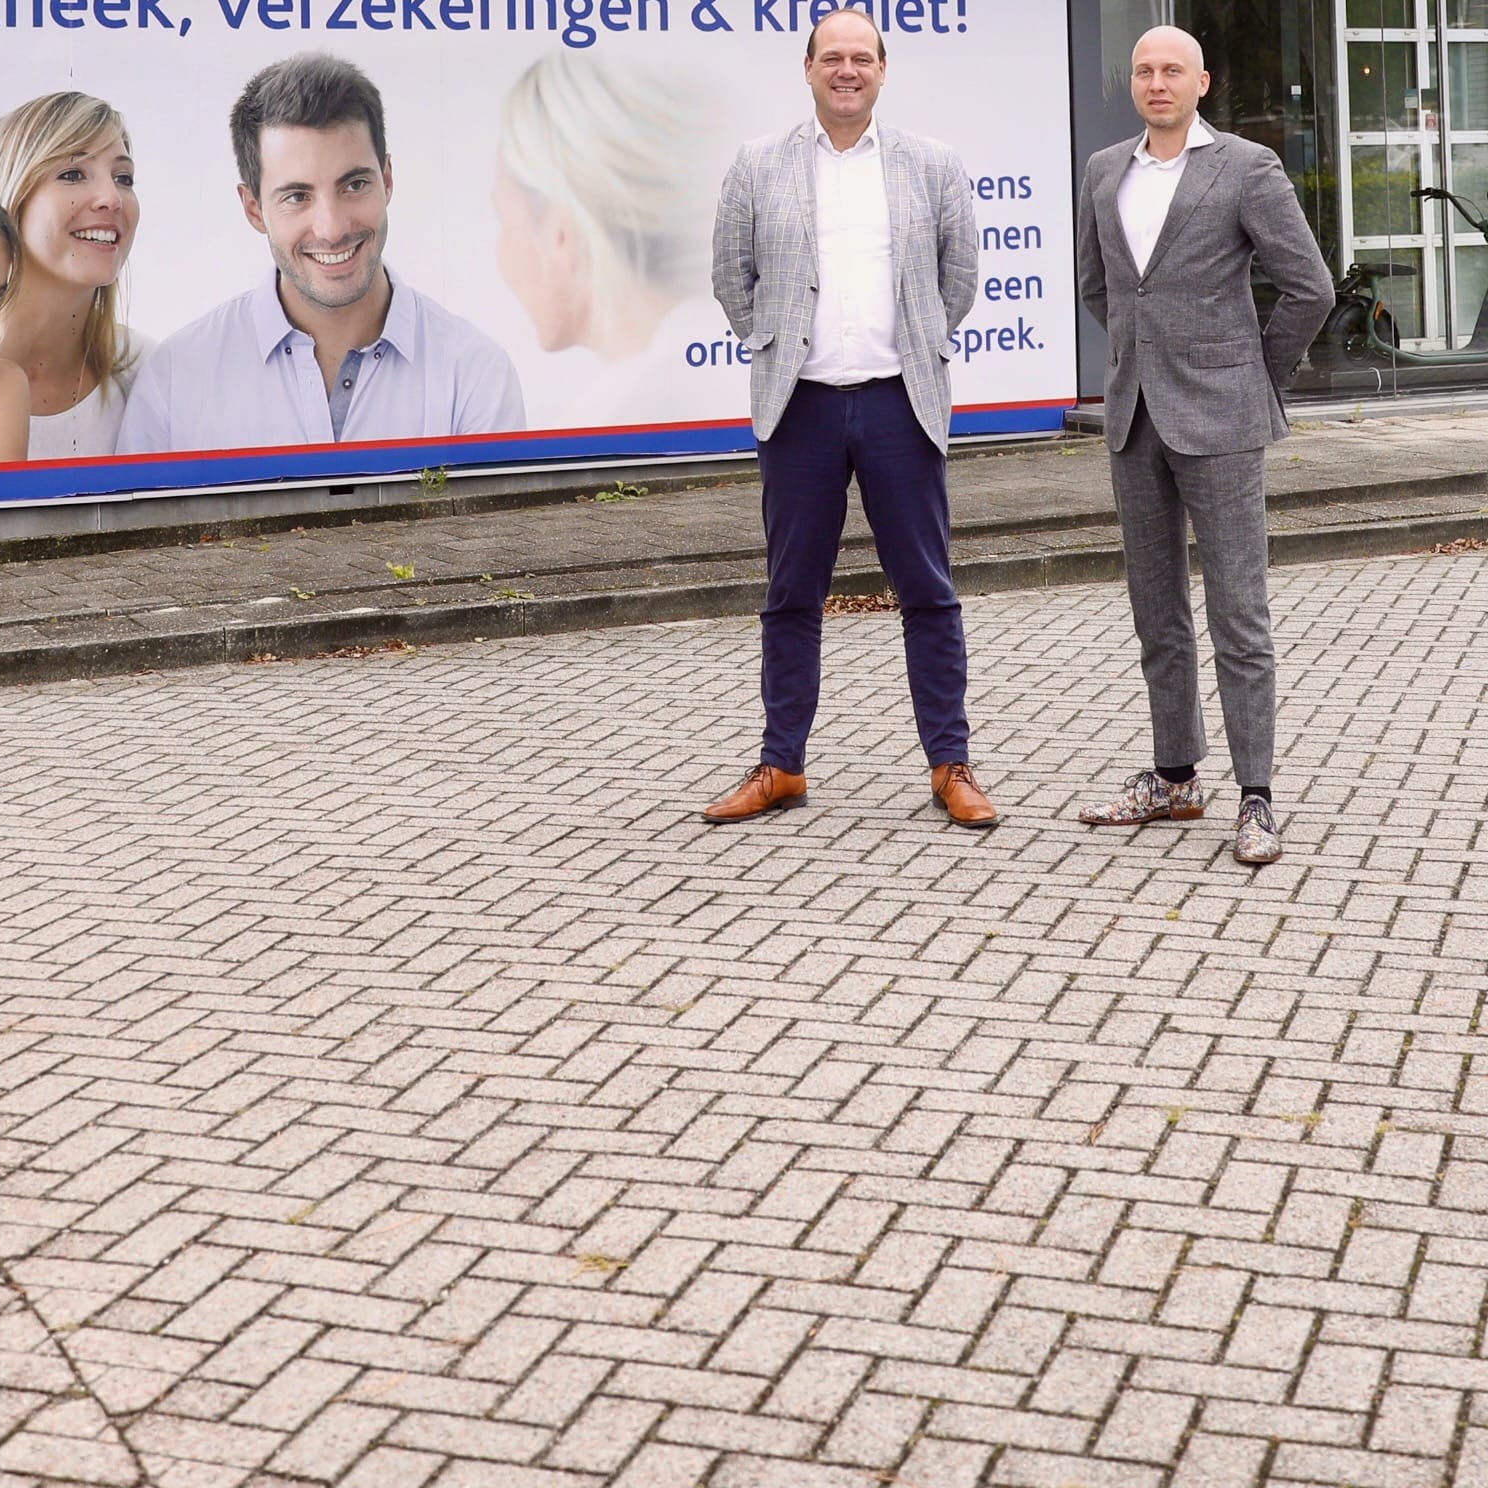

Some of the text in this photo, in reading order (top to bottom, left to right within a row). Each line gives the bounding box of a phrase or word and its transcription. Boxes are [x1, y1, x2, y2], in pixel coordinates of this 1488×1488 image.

[969, 175, 1032, 200] ens
[976, 225, 1042, 251] nen
[984, 275, 1043, 302] een
[685, 316, 1045, 368] orie sprek.
